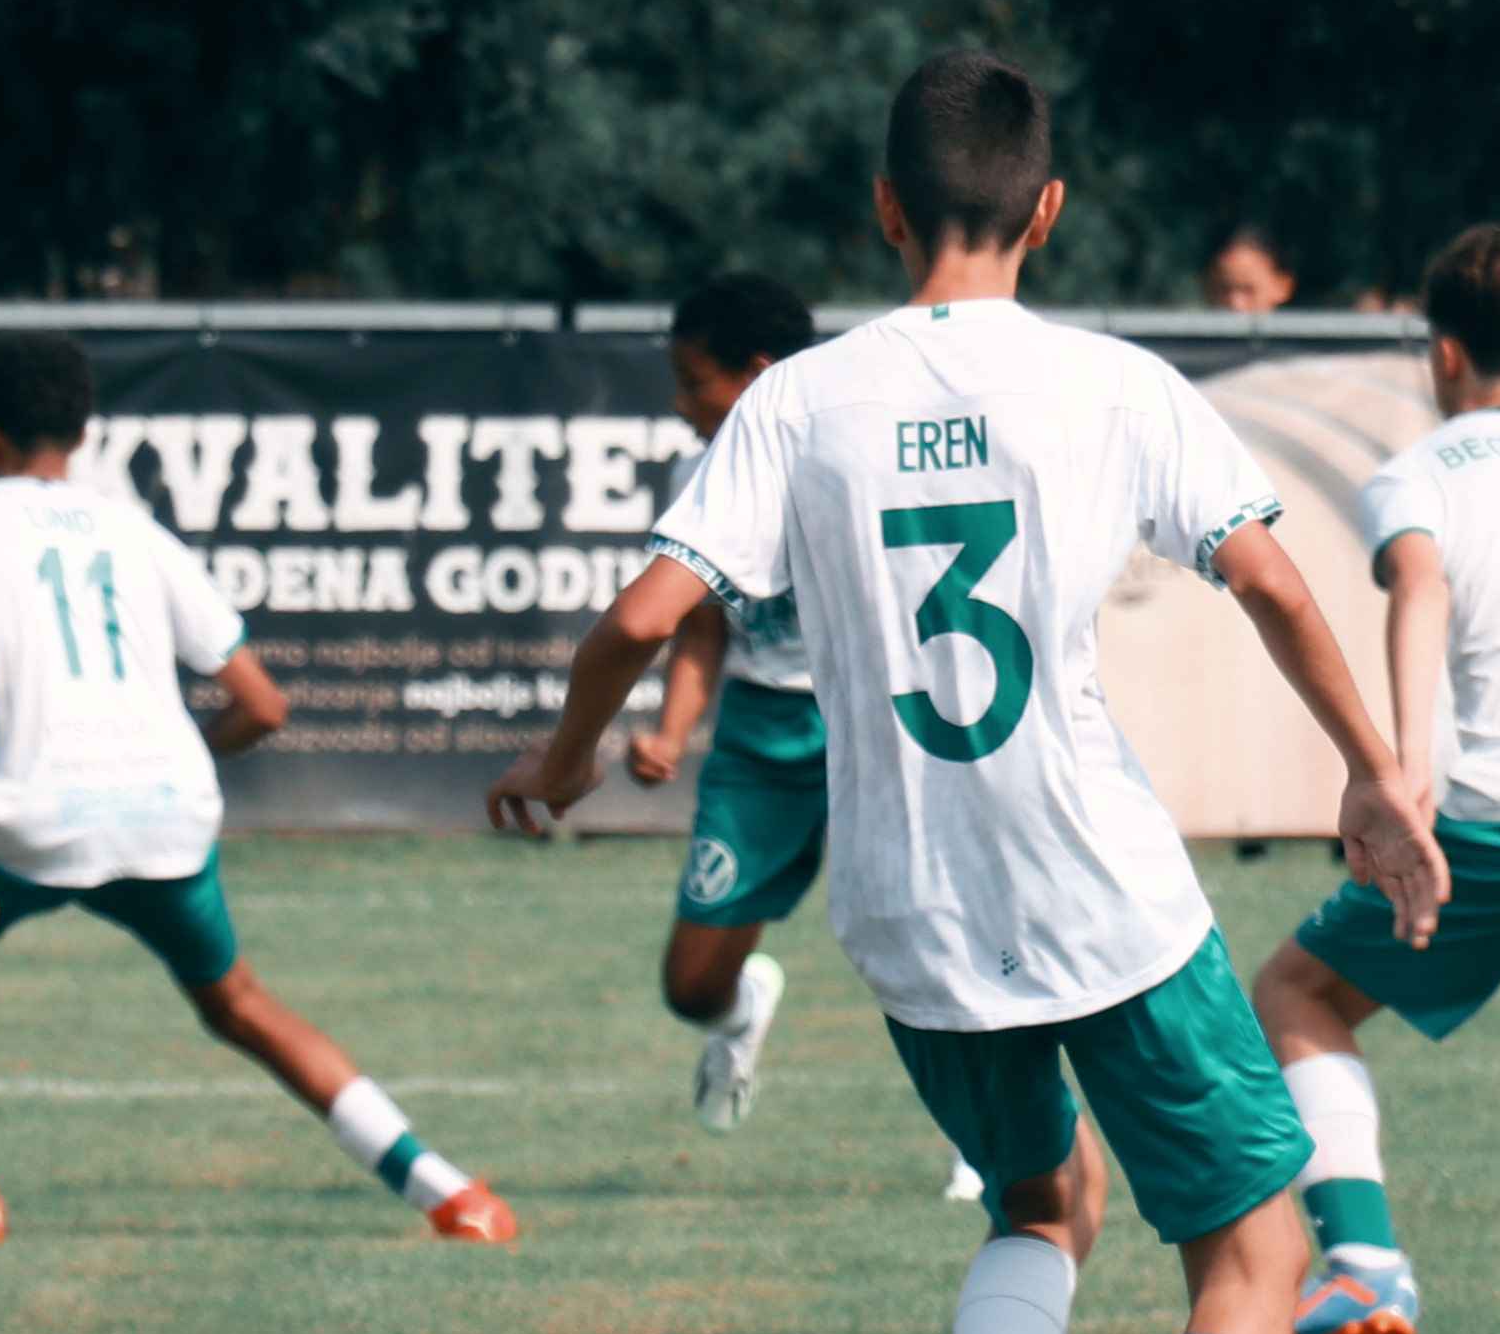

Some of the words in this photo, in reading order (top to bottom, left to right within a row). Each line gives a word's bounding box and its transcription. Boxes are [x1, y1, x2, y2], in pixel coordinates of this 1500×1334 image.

[897, 415, 988, 473] EREN
[36, 546, 127, 681] 11
[883, 499, 1033, 762] 3
